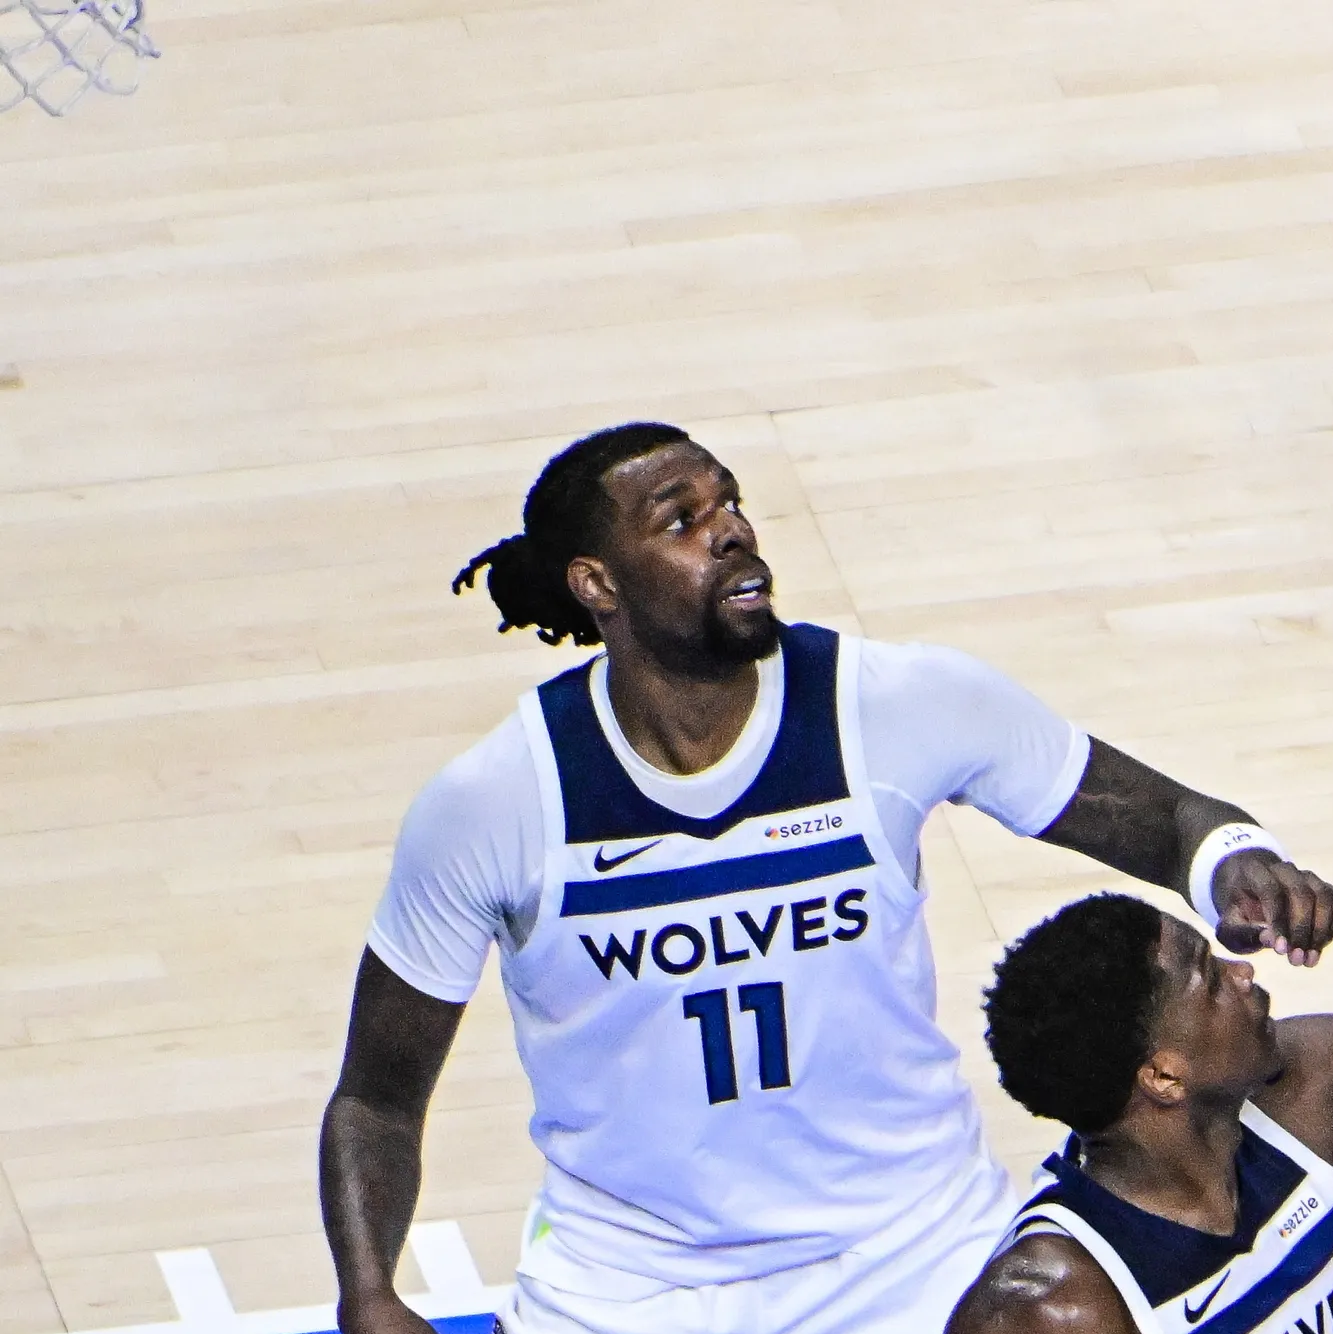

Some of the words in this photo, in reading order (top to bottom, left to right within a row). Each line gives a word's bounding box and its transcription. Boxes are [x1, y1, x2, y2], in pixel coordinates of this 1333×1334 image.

[779, 813, 843, 838] sezzle
[579, 888, 869, 980] WOLVES
[682, 981, 791, 1105] 11
[1283, 1196, 1319, 1234] sezzle
